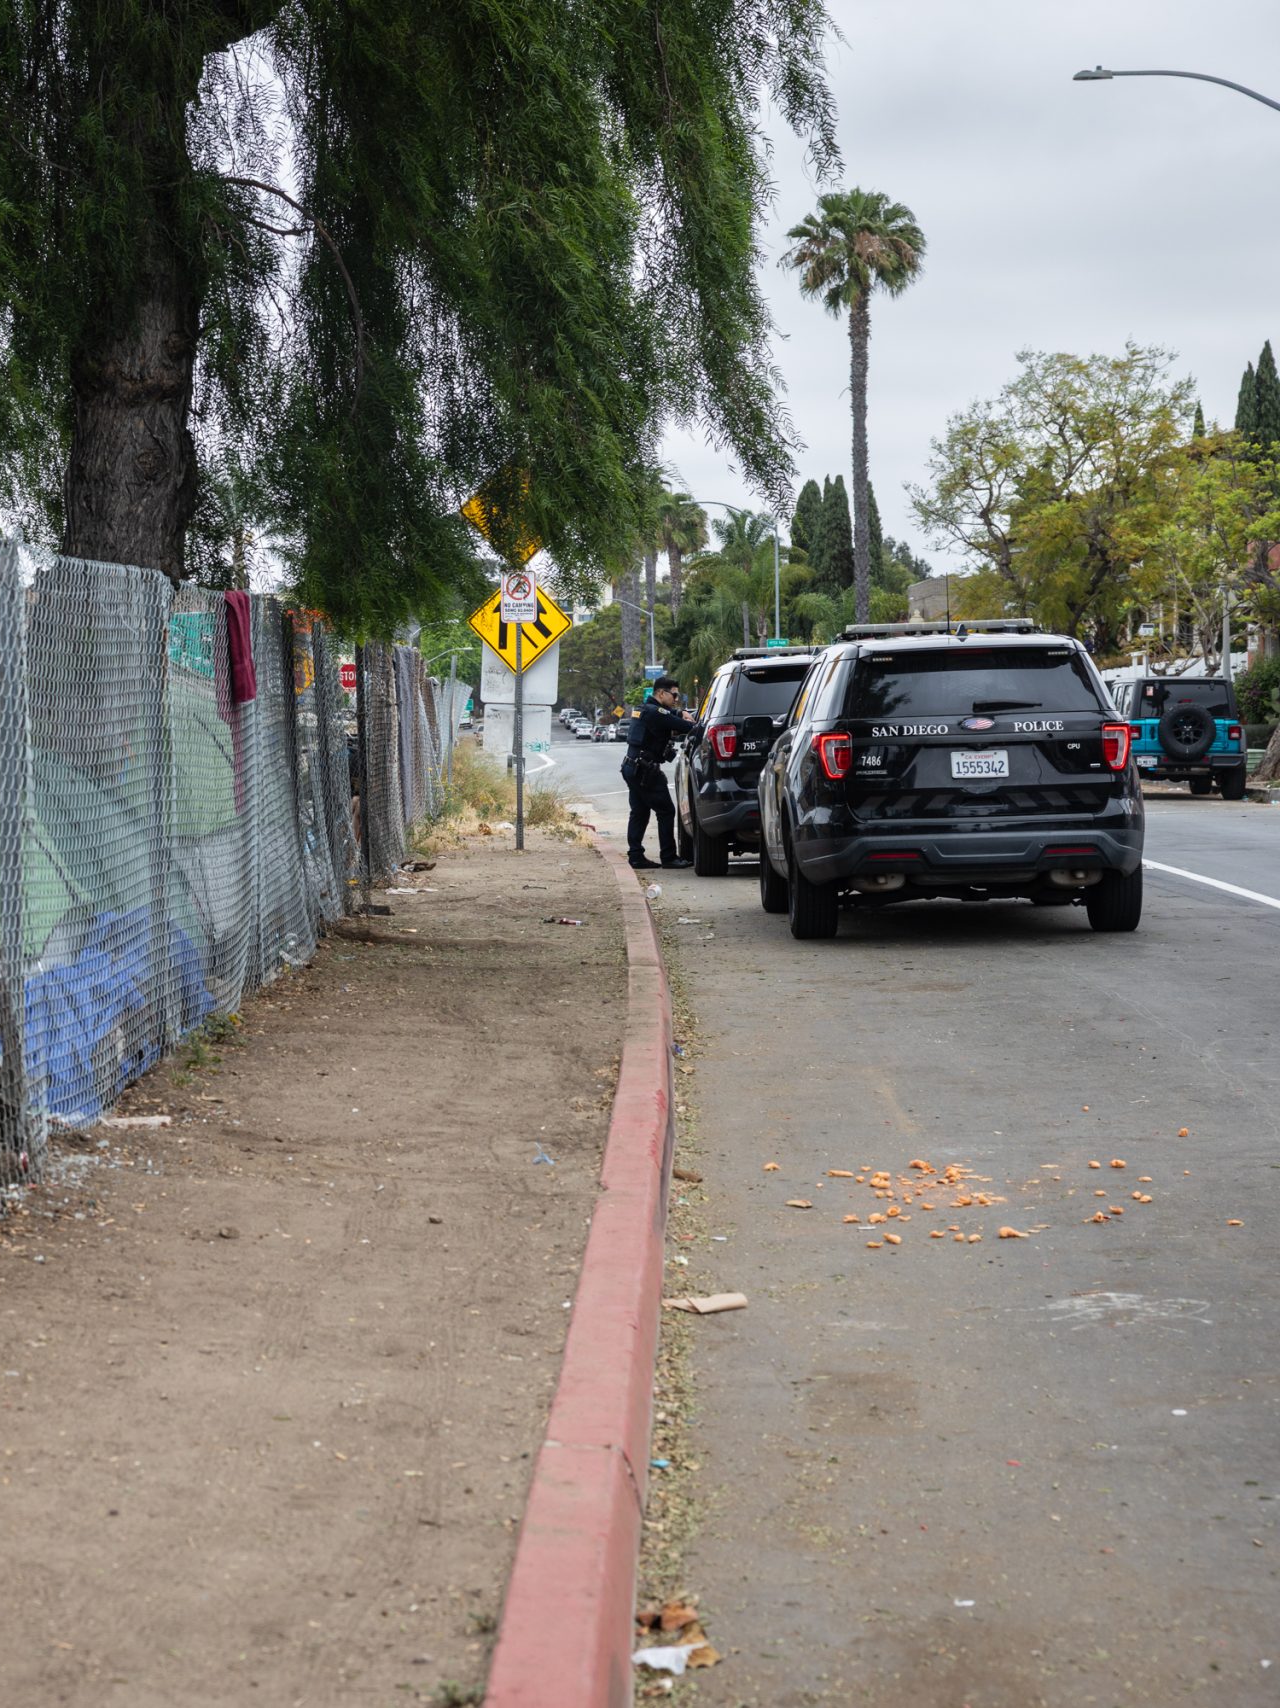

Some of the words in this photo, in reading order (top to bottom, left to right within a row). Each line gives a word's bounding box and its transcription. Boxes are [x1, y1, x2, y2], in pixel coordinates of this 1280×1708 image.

[339, 671, 357, 681] STO
[872, 725, 899, 738] SAN
[902, 724, 949, 736] DIEGO
[1014, 720, 1064, 732] POLICE
[861, 755, 881, 767] 7486
[955, 760, 1005, 775] 1555342
